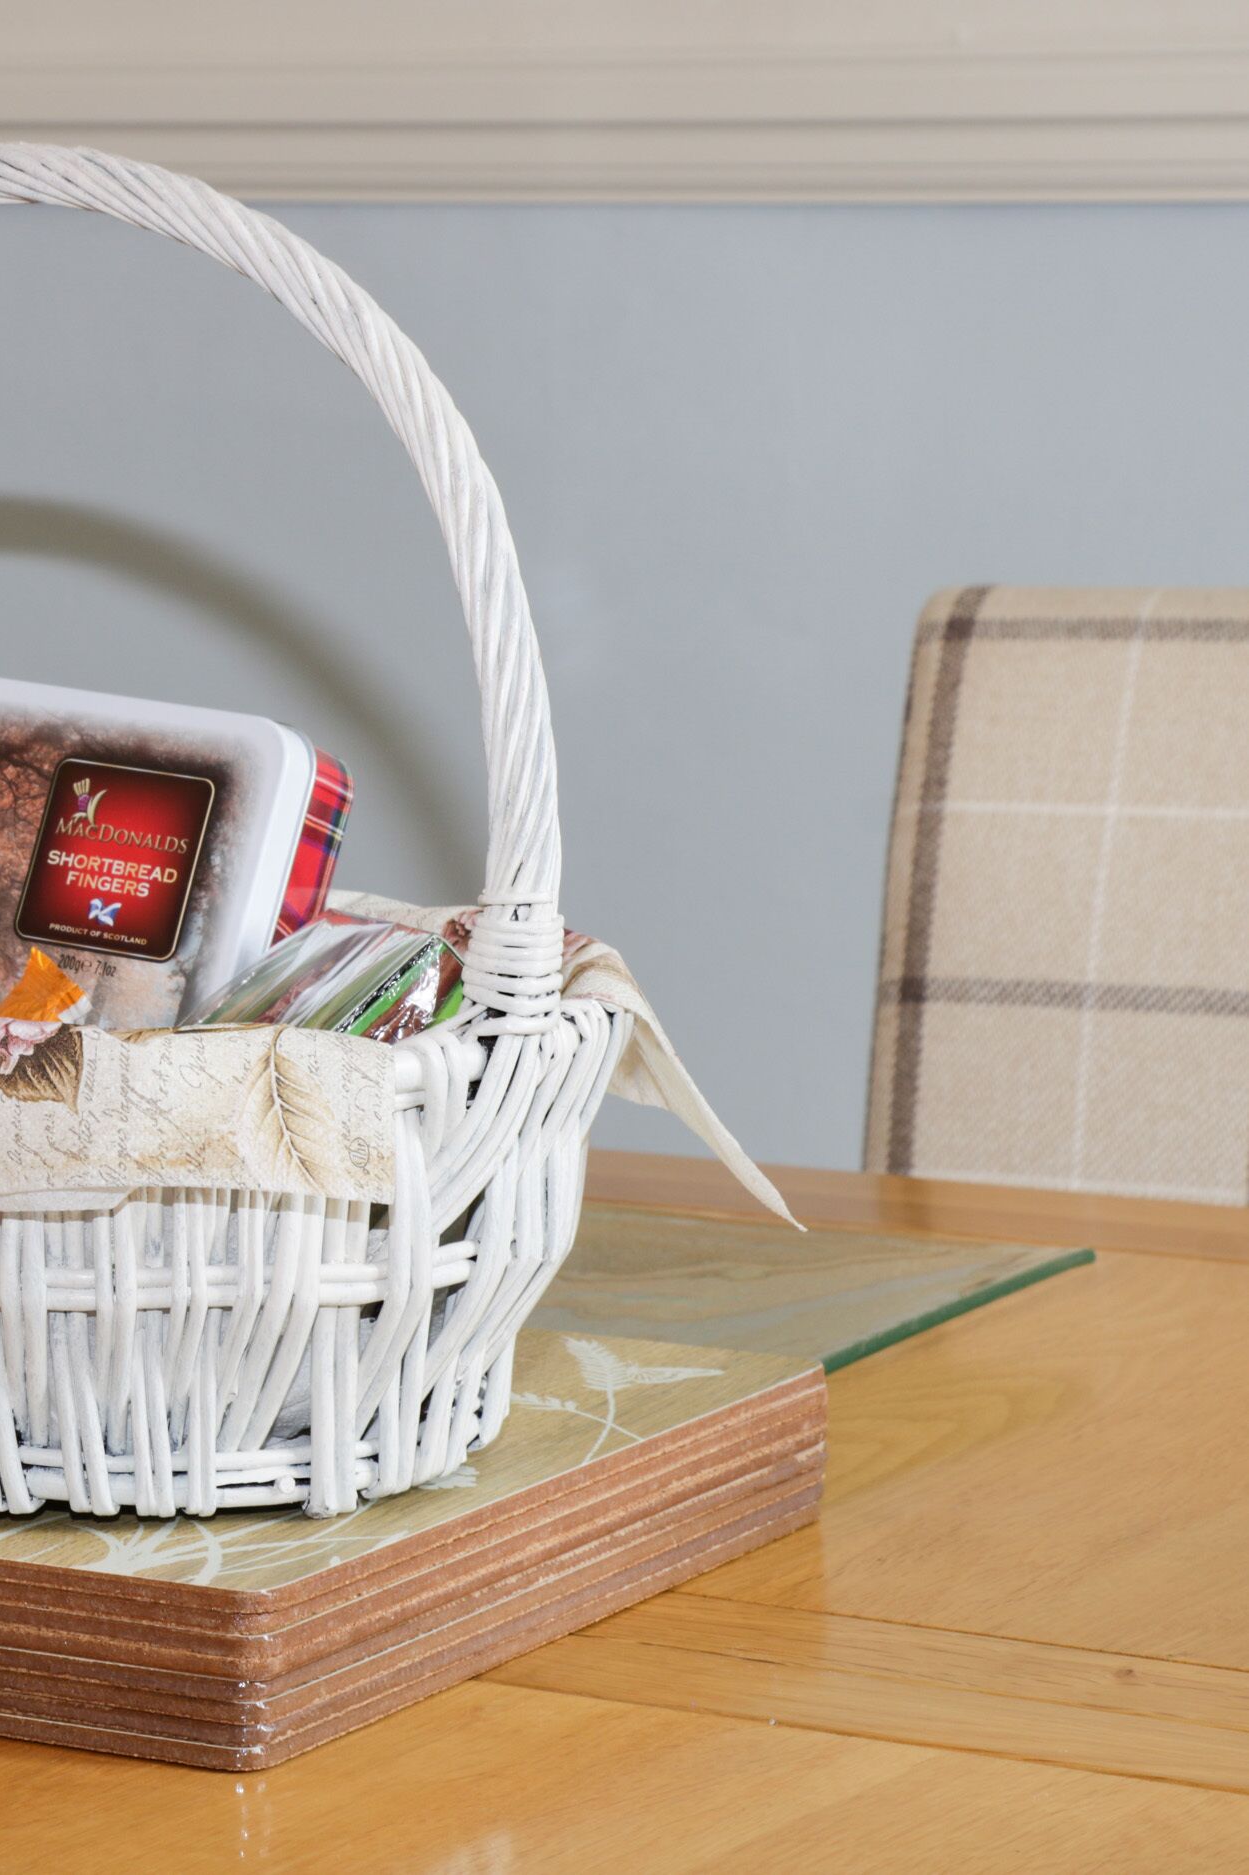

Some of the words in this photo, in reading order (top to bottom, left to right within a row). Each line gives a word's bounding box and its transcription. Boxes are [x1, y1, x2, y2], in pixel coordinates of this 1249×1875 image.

[47, 849, 178, 884] SHORTBREAD
[66, 870, 150, 898] FINGERS
[49, 923, 88, 935] PRODUCT
[89, 930, 101, 938] OF
[103, 931, 147, 945] SCOTLAND
